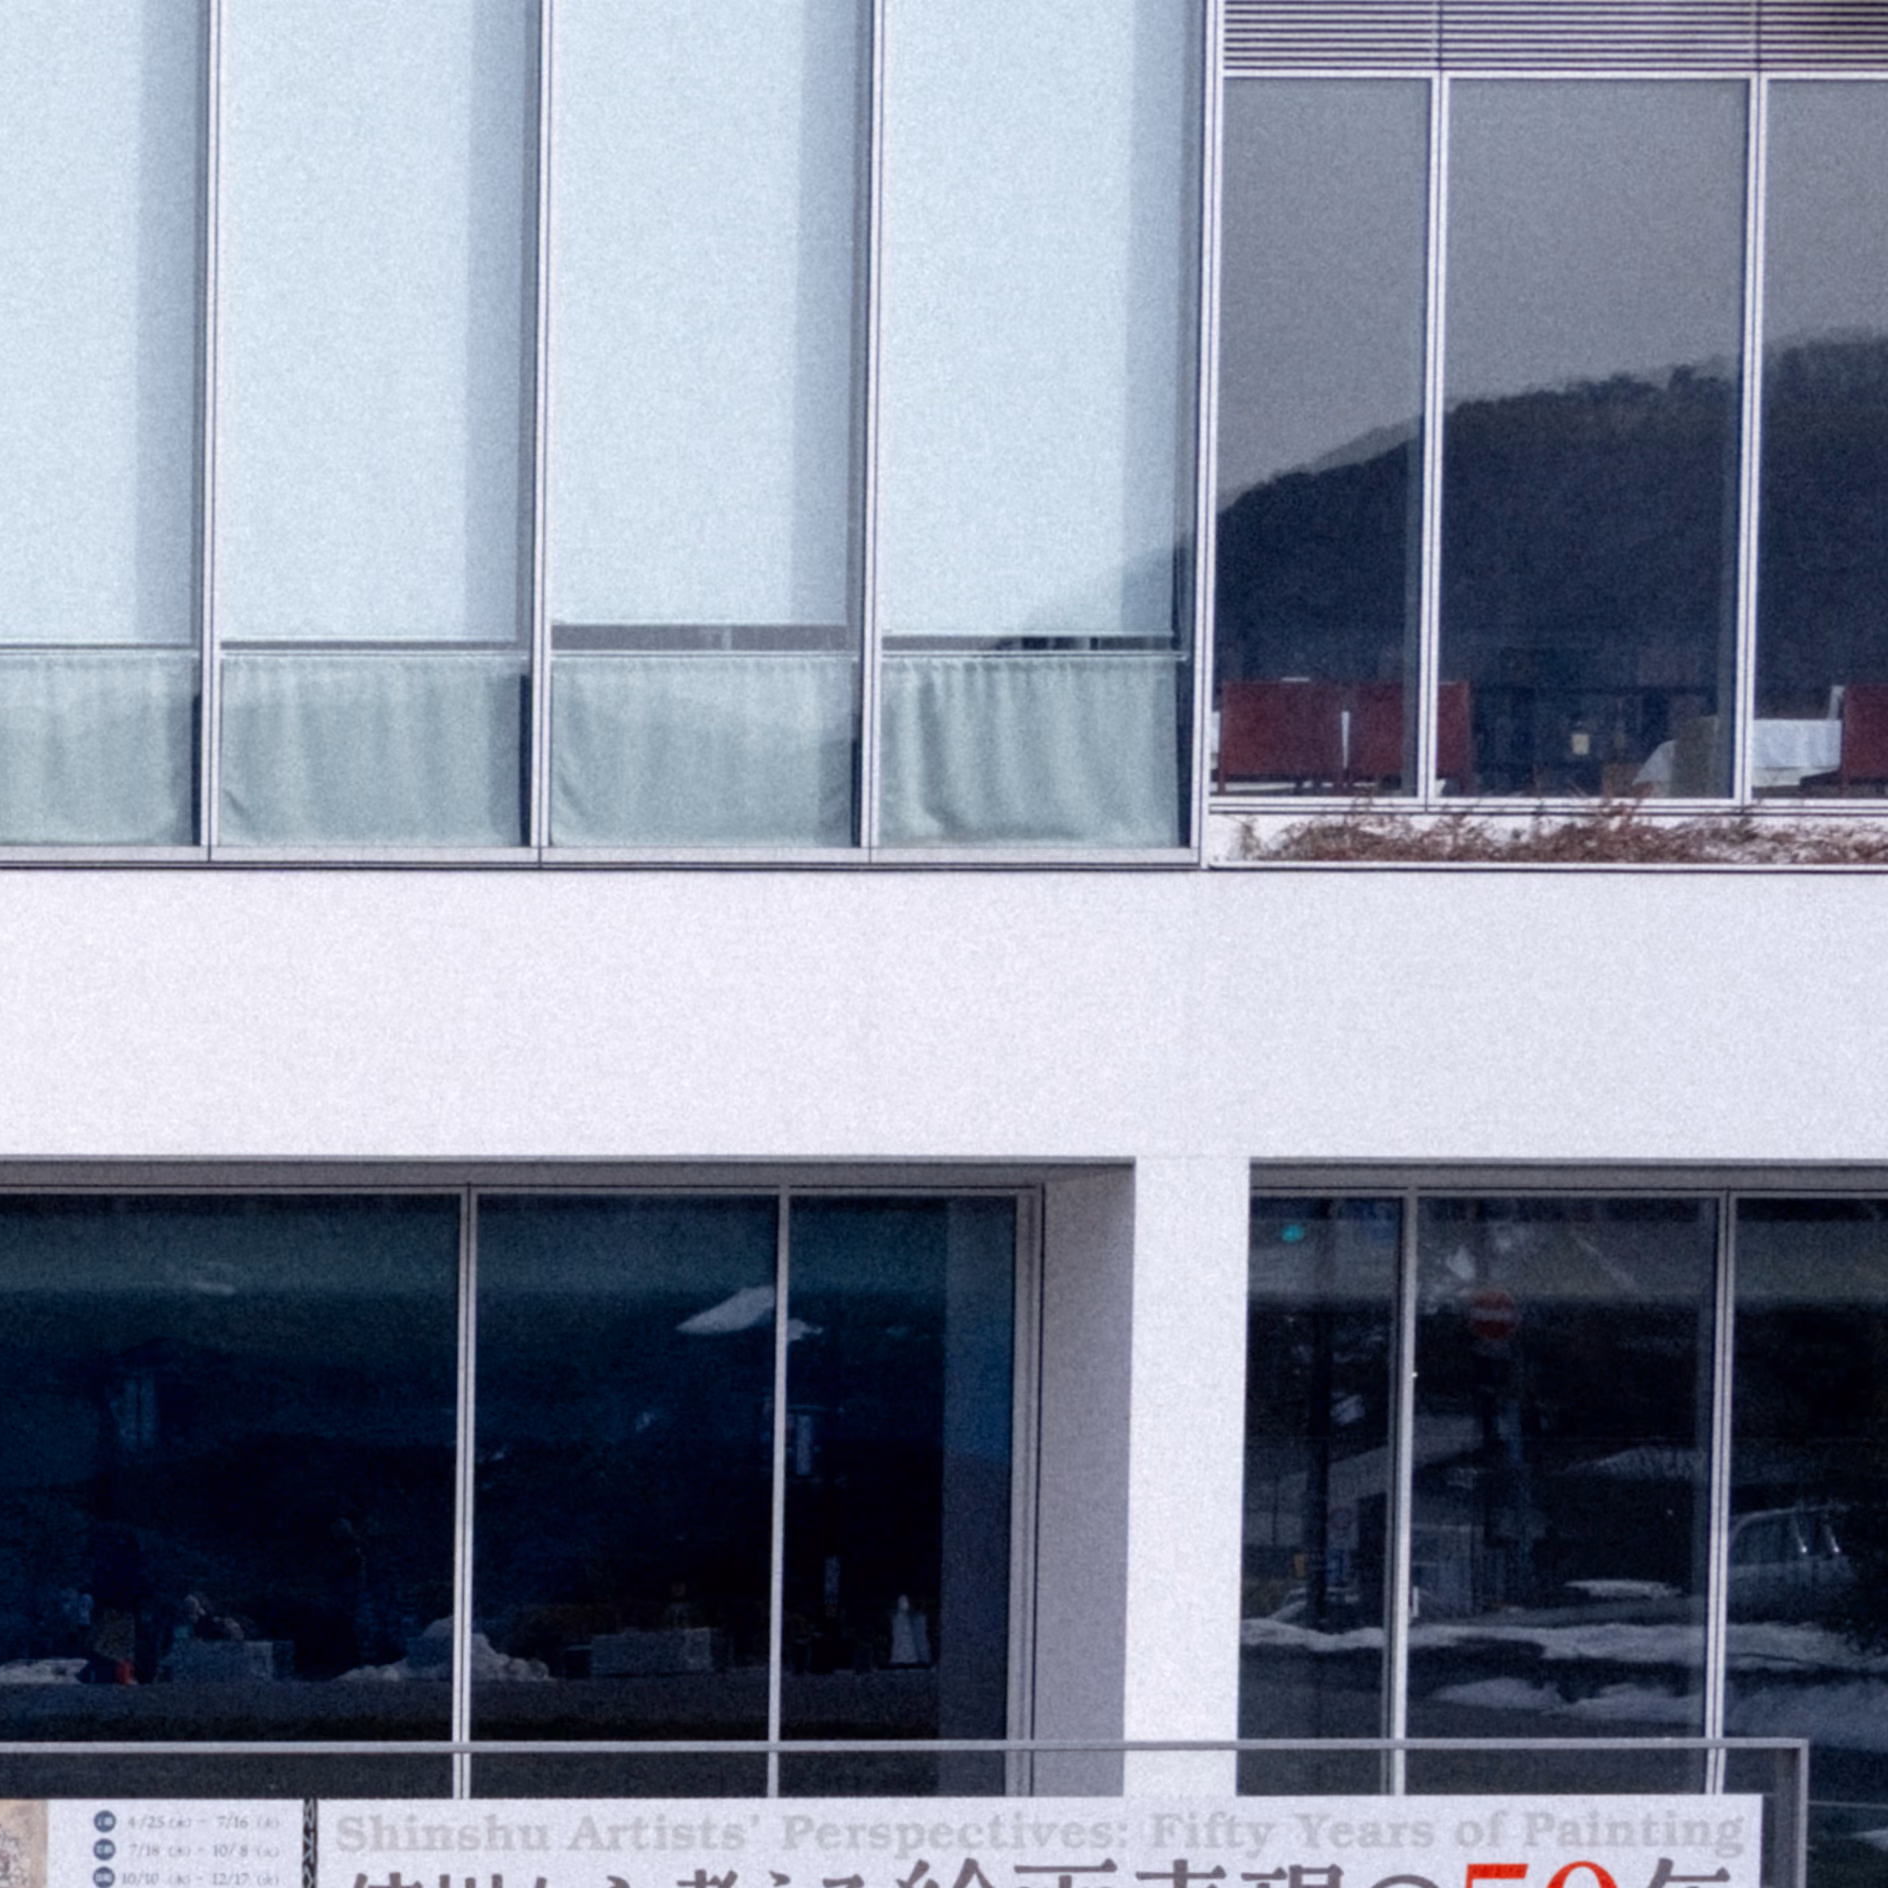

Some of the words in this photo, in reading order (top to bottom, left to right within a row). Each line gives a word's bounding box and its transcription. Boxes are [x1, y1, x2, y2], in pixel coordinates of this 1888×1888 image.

[335, 1813, 550, 1853] Shinshu
[780, 1811, 1127, 1858] Perspectives:
[1151, 1811, 1272, 1858] Fifty
[1294, 1811, 1436, 1849] Years
[1454, 1809, 1506, 1848] of
[1524, 1810, 1746, 1859] Painting
